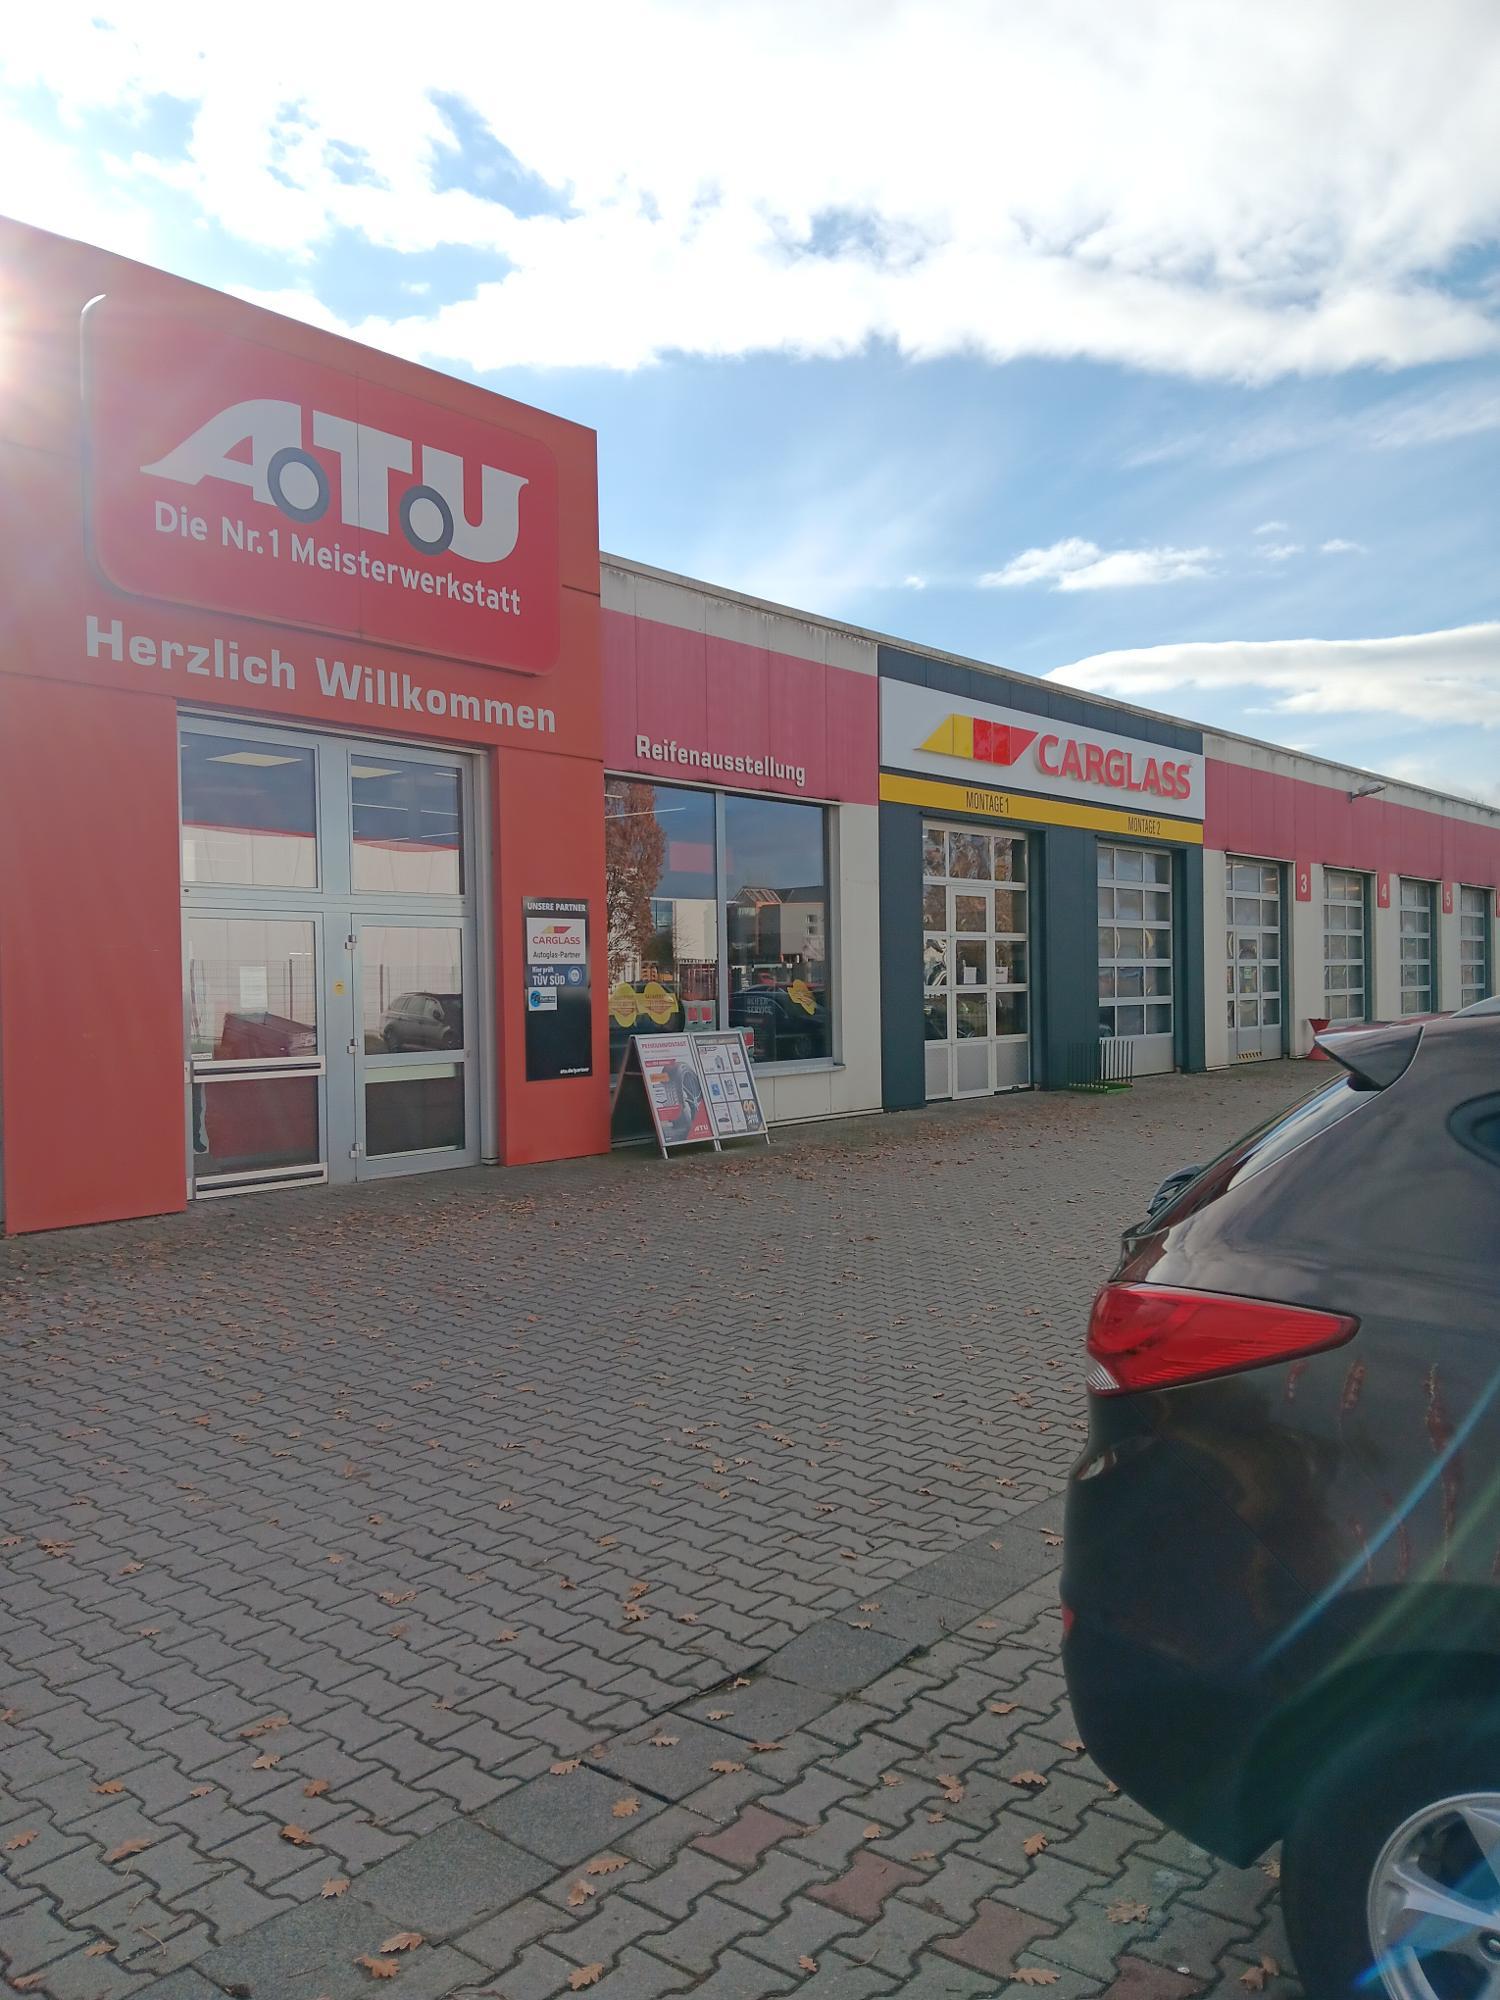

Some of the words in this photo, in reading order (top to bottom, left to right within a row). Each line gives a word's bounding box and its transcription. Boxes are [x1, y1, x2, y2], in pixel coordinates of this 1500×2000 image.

[155, 500, 208, 541] Die
[290, 533, 521, 616] Meisterwerkstatt
[85, 615, 296, 690] Herzlich
[315, 657, 556, 733] Willkommen
[635, 734, 806, 787] Reifenausstellung
[1035, 733, 1191, 800] CARGLASS
[965, 791, 1004, 813] MONTAGE
[1005, 798, 1010, 815] 1
[1127, 816, 1154, 835] MONTAGE
[1156, 822, 1161, 836] 2
[1300, 874, 1308, 893] 3
[1381, 883, 1388, 899] 4
[527, 902, 555, 911] UNSERE
[555, 903, 586, 912] PARTNER
[1445, 893, 1451, 906] 5
[532, 936, 581, 945] CARGLASS
[532, 951, 581, 960] Autoglas-Partner
[532, 973, 549, 986] TÜV
[550, 973, 566, 986] SÜD
